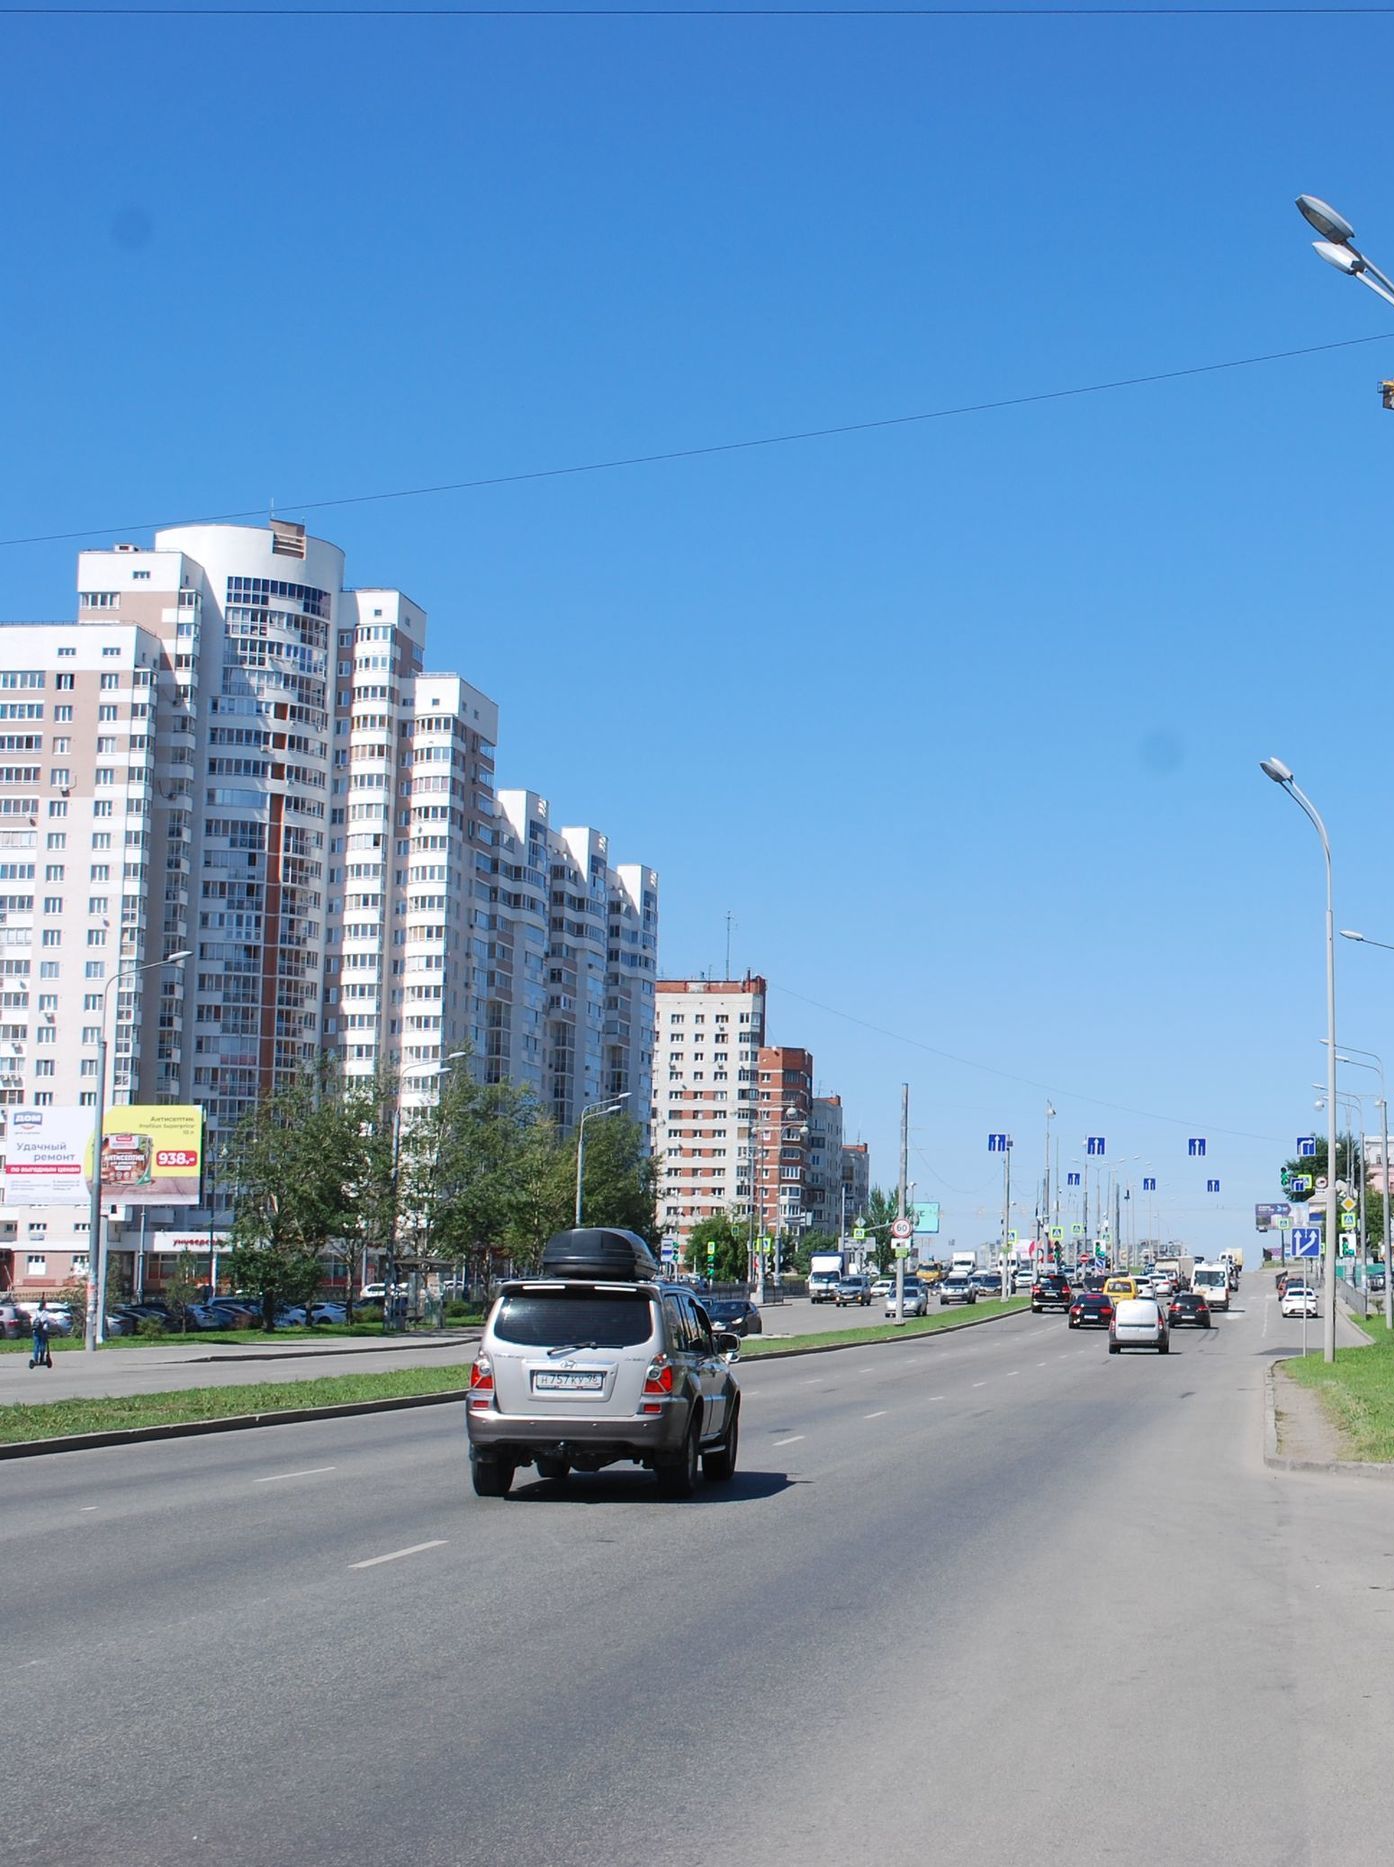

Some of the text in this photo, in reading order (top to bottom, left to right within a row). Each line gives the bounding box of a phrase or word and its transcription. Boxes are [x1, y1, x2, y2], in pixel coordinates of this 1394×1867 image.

[16, 1142, 67, 1152] Удачный
[33, 1154, 76, 1163] ремонт
[896, 1224, 908, 1232] 60
